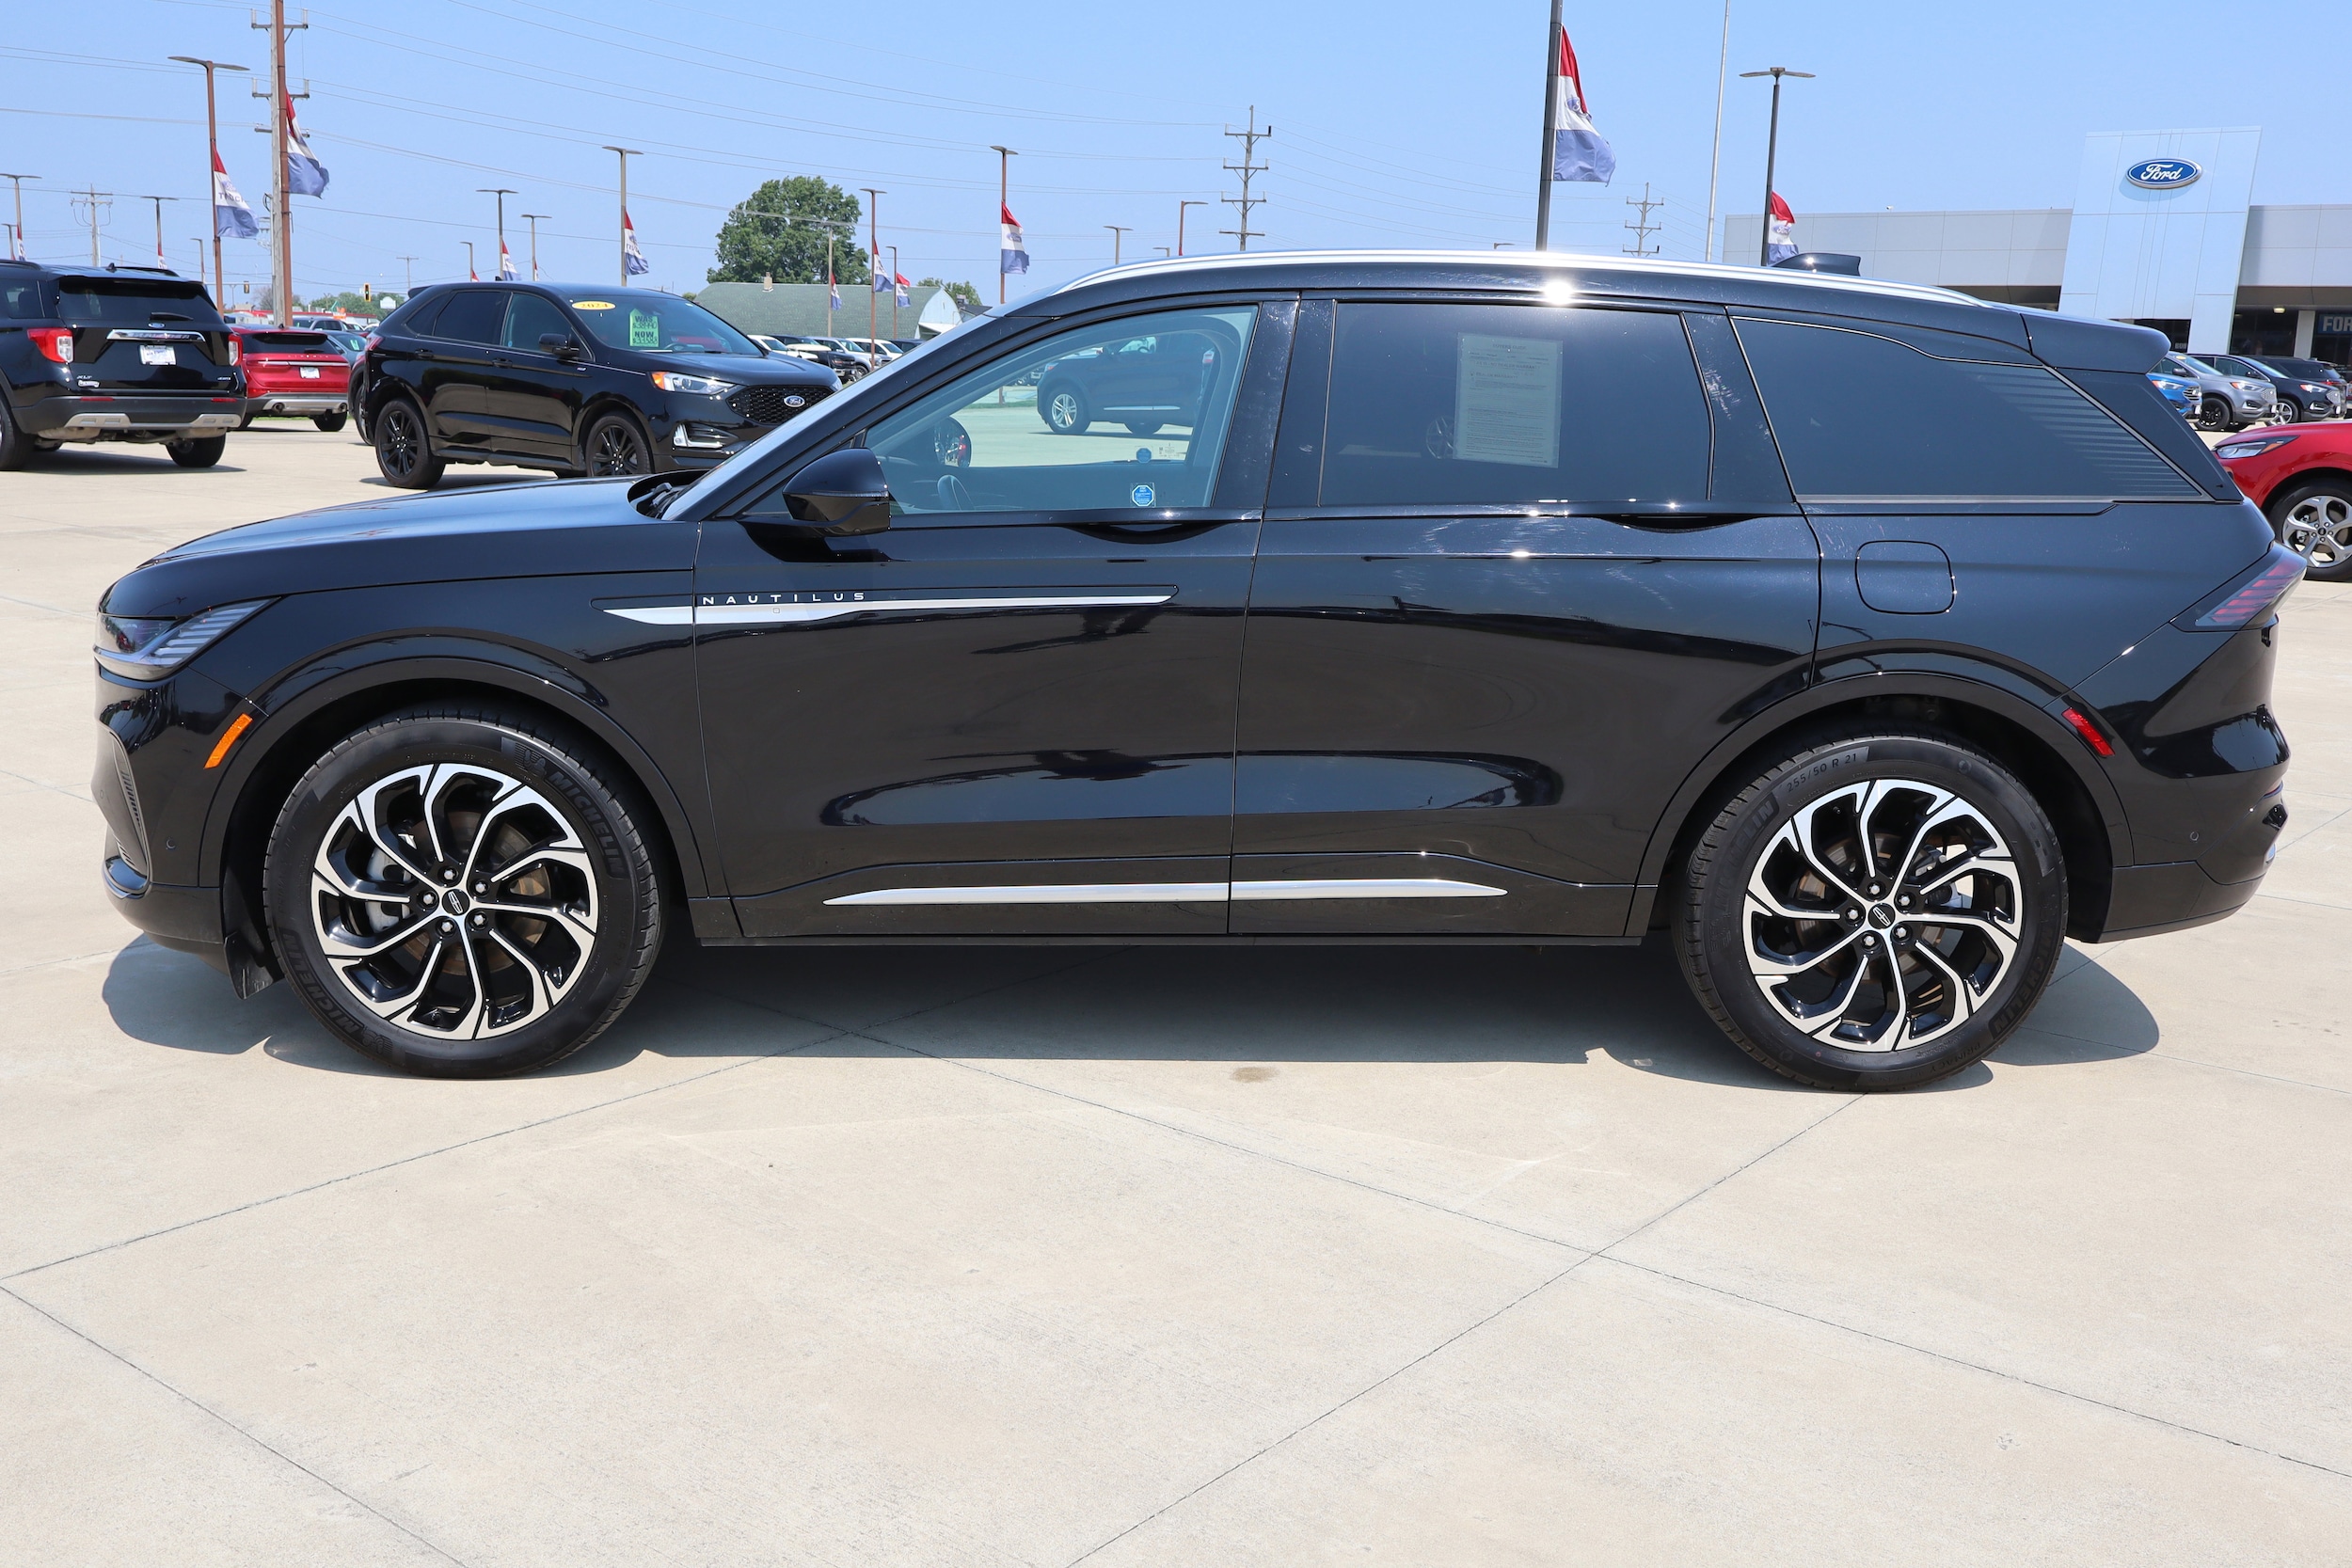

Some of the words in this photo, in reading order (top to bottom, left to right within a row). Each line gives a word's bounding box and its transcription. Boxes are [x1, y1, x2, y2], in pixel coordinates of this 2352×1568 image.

[2140, 163, 2182, 182] Ford
[702, 592, 865, 605] NAUTILUS
[548, 770, 627, 874] MICHELIN
[1787, 763, 1827, 793] 255/50
[1832, 758, 1839, 768] R
[1844, 753, 1856, 764] 21
[1714, 800, 1774, 911] MICHELIN
[282, 933, 361, 1034] MICHELIN
[1993, 927, 2055, 1034] MICHELIN
